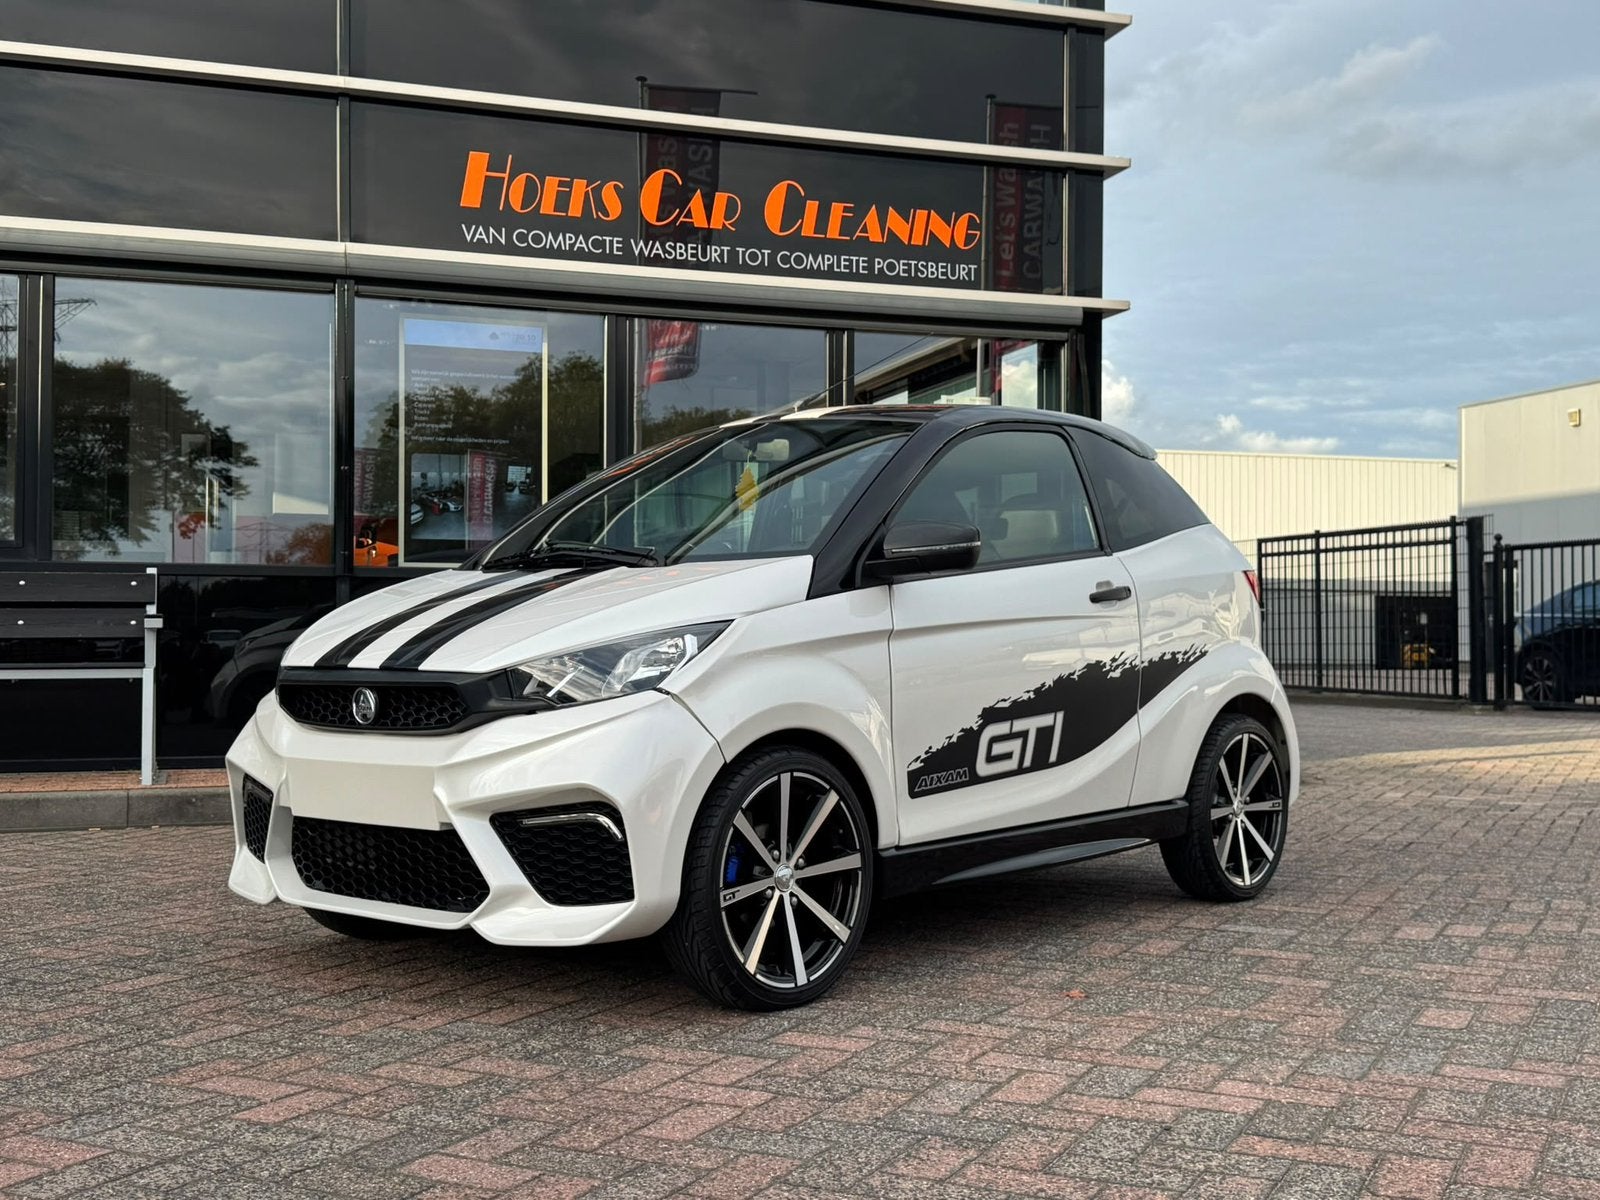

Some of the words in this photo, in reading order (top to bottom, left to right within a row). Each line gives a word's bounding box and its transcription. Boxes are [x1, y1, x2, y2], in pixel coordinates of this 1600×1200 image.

[995, 122, 1020, 206] Wah
[1022, 123, 1052, 279] CARWAH
[461, 223, 506, 246] VAN
[512, 228, 623, 255] COMPACTE
[630, 238, 731, 264] WASBEURT
[735, 246, 772, 267] TOT
[776, 251, 869, 274] COMPLETE
[874, 257, 978, 281] POETSBEURT
[975, 711, 1065, 778] GTI
[914, 767, 970, 792] AIXAM
[723, 889, 741, 902] GT
